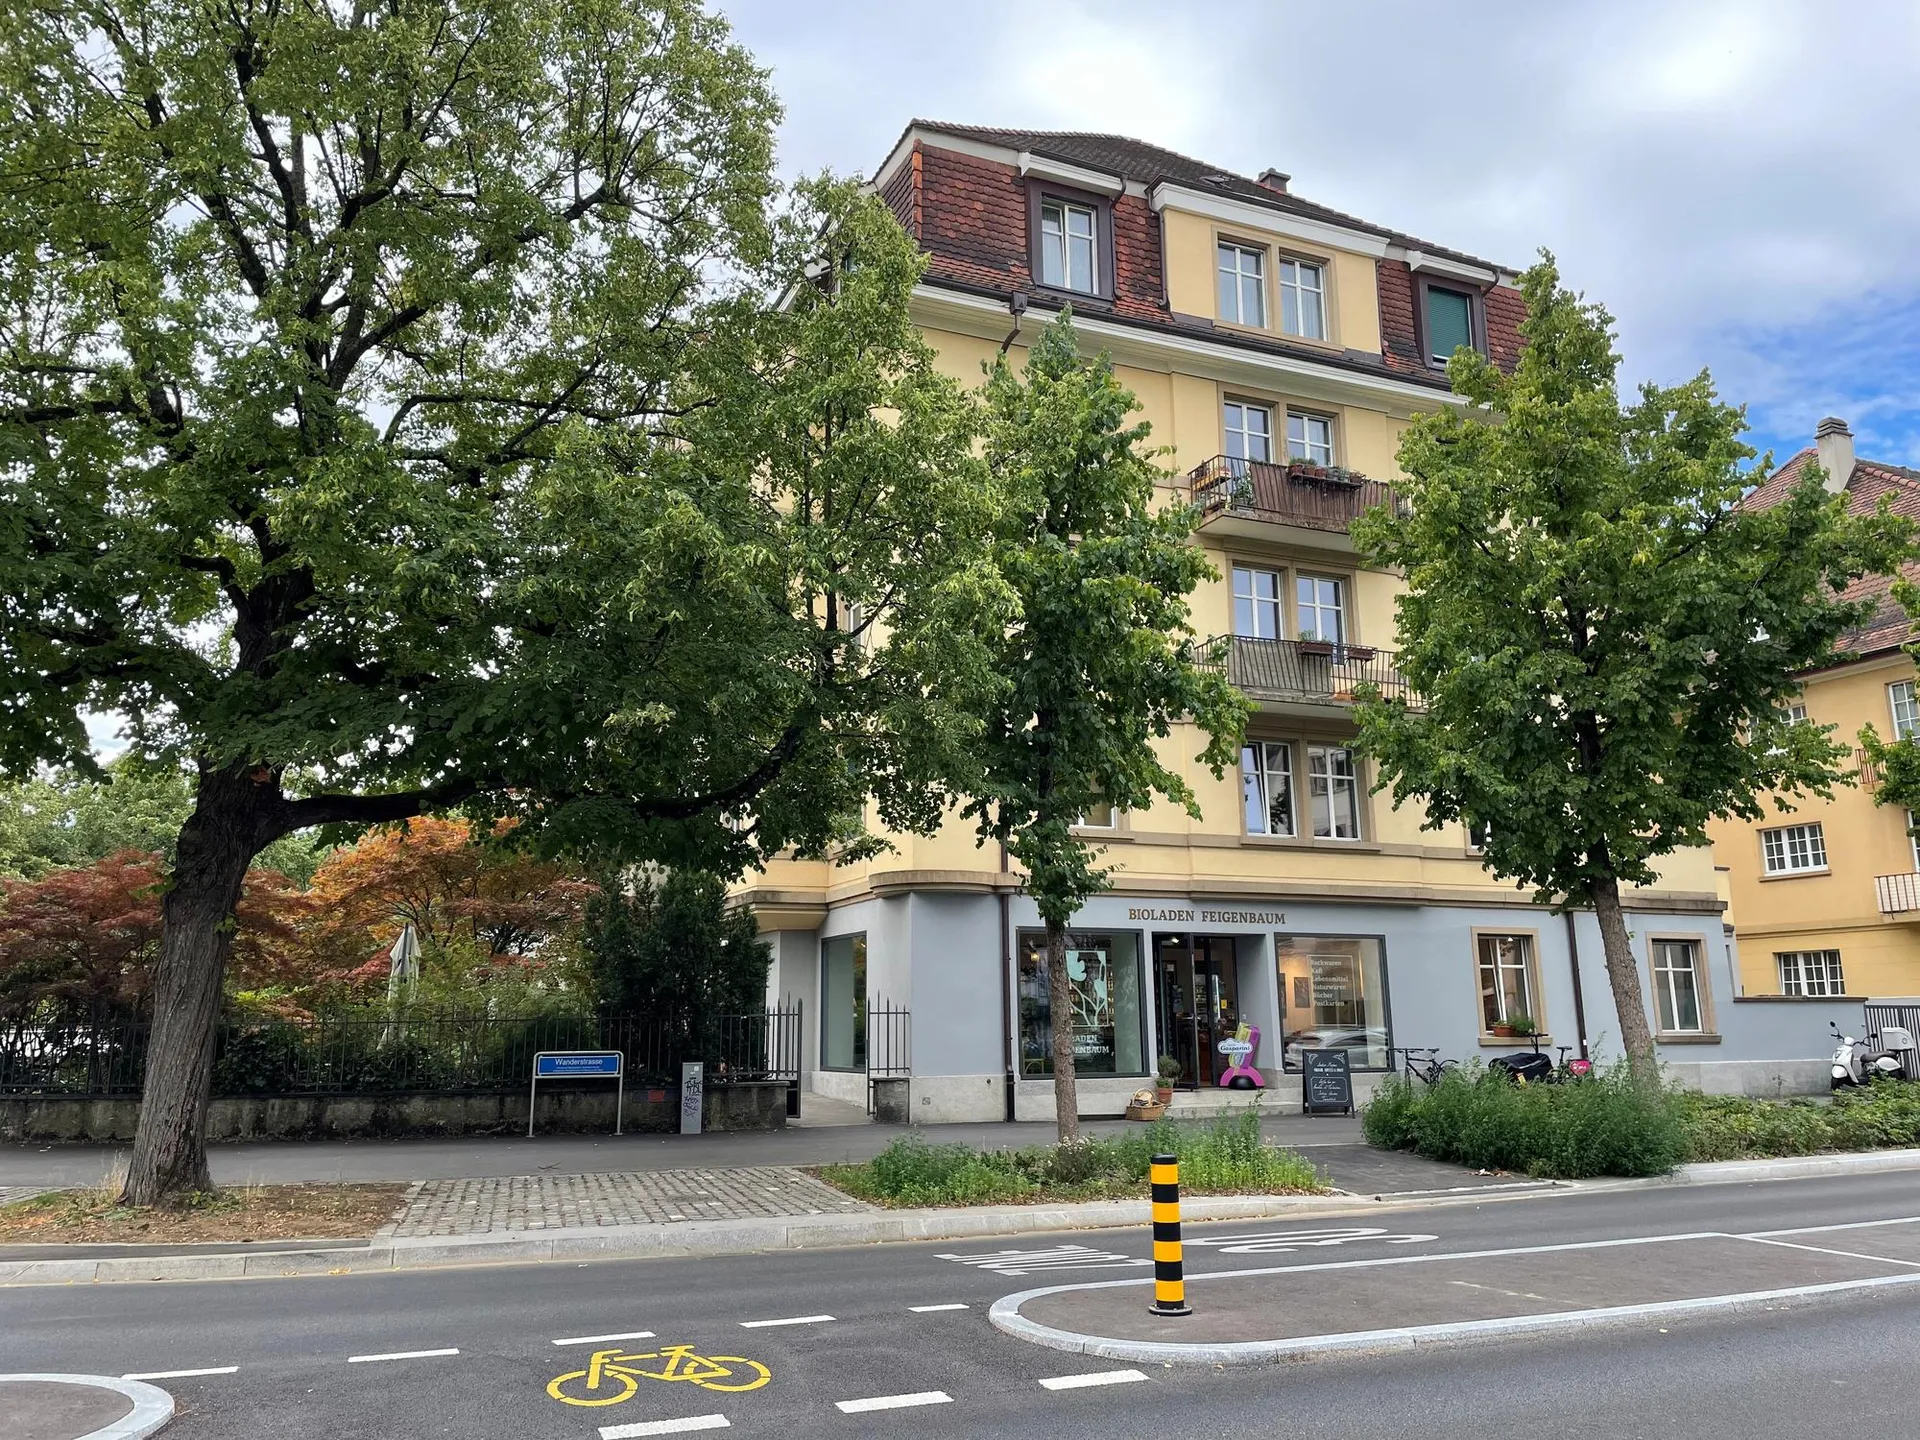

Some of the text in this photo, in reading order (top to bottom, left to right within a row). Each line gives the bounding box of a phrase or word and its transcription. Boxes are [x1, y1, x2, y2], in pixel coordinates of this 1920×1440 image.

[1128, 908, 1286, 924] BIOLADEN FEIGENBAUM
[1072, 1034, 1098, 1043] ADEN
[1071, 1045, 1110, 1054] ENBAUM
[554, 1058, 604, 1066] Wanderstrasse
